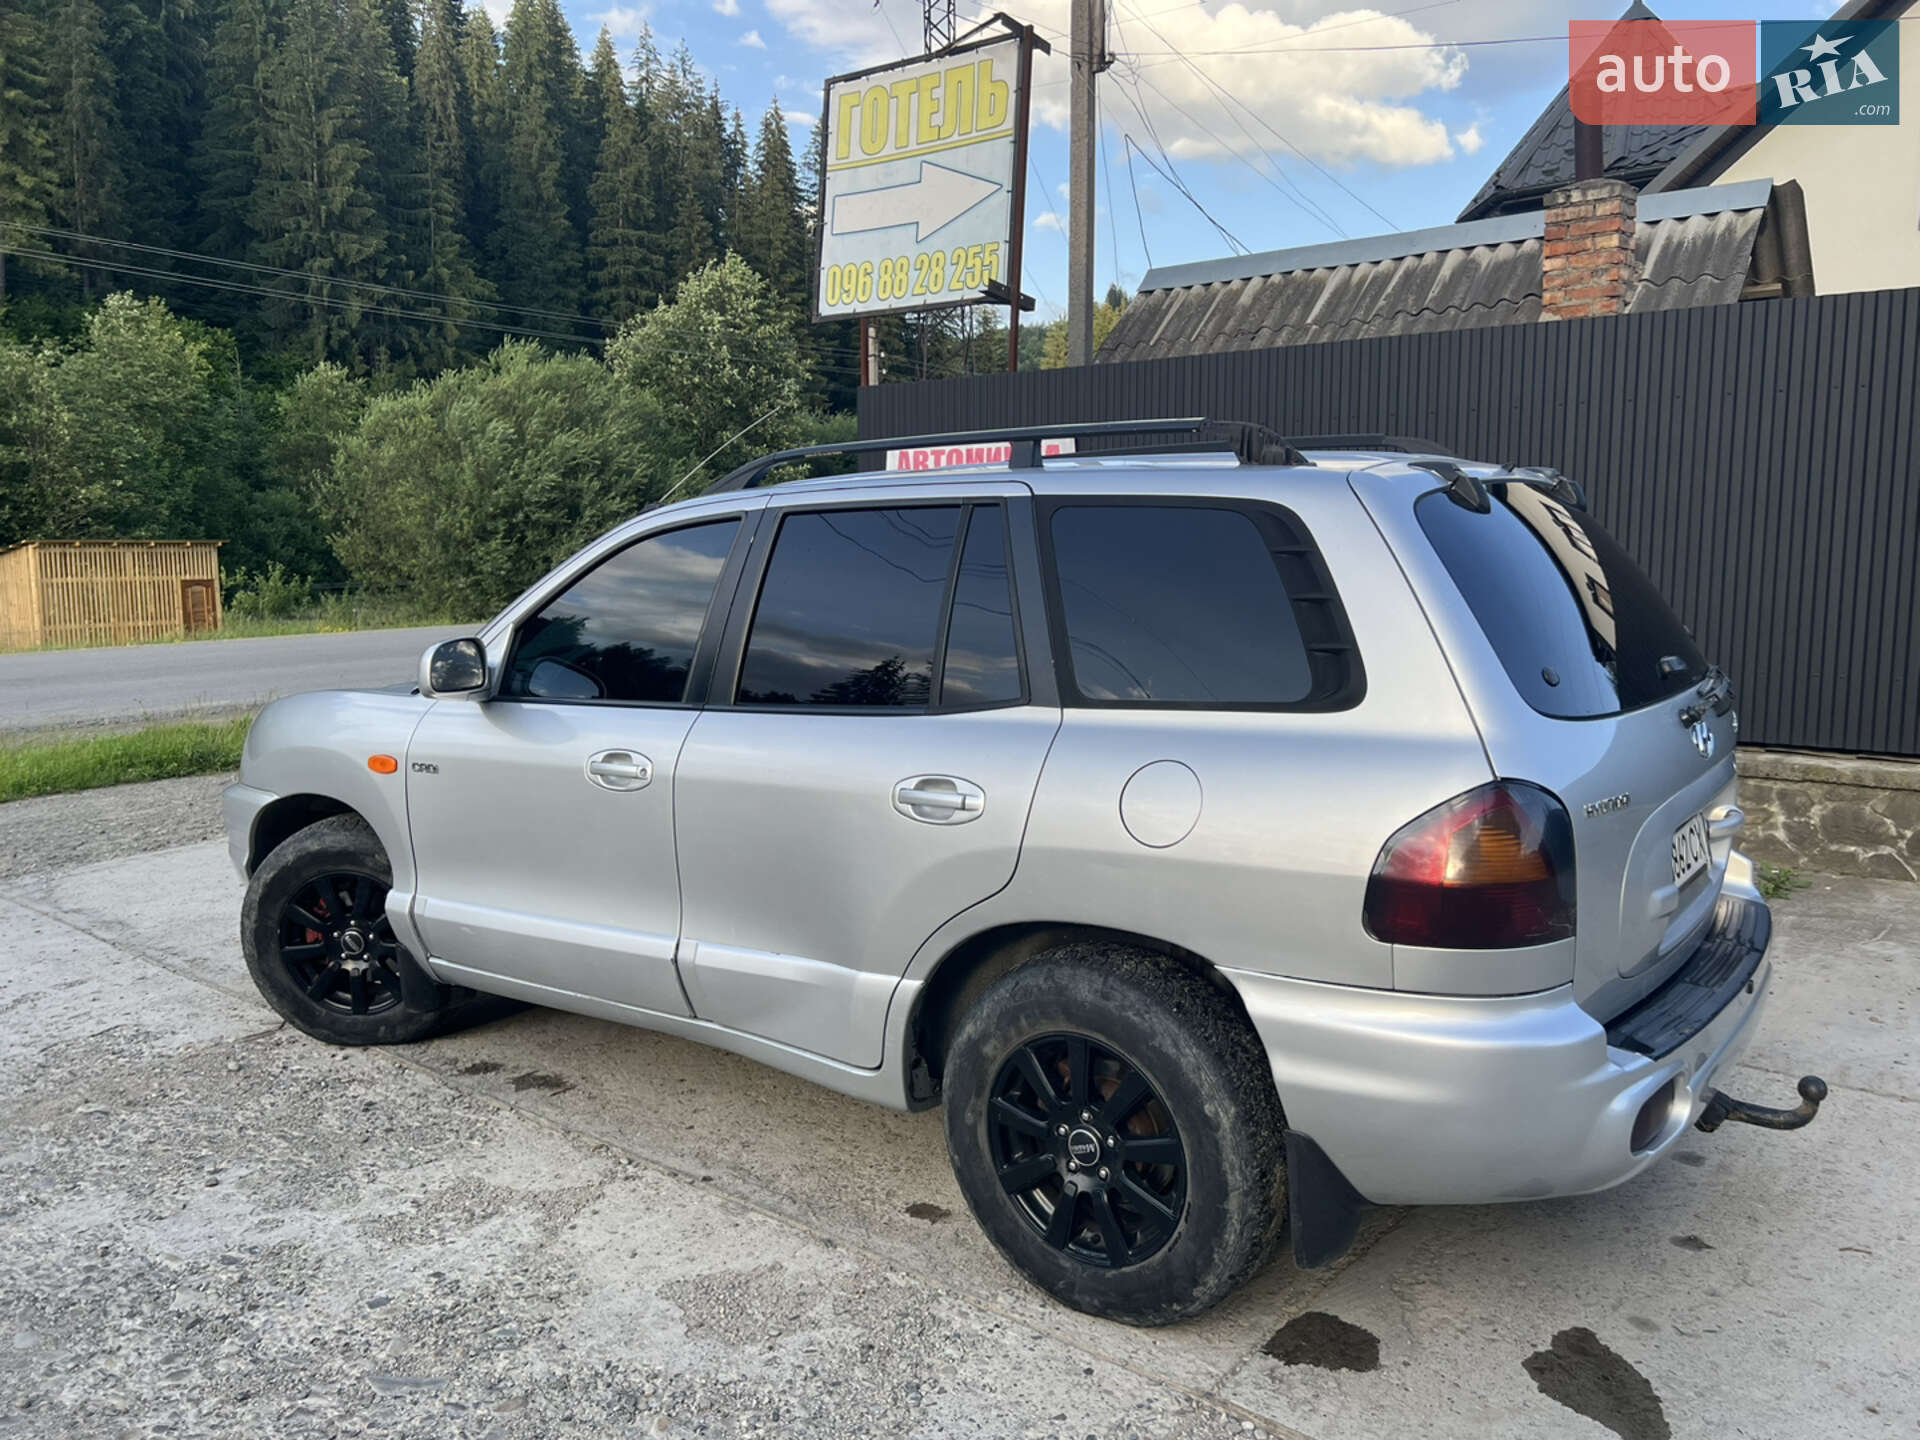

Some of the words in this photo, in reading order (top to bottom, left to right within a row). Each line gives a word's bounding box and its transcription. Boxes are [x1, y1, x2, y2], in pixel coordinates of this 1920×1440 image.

[836, 59, 1009, 160] ГОТЕЛЬ
[826, 261, 873, 306] 096
[877, 256, 910, 300] 88
[912, 250, 946, 296] 28
[948, 242, 999, 291] 255
